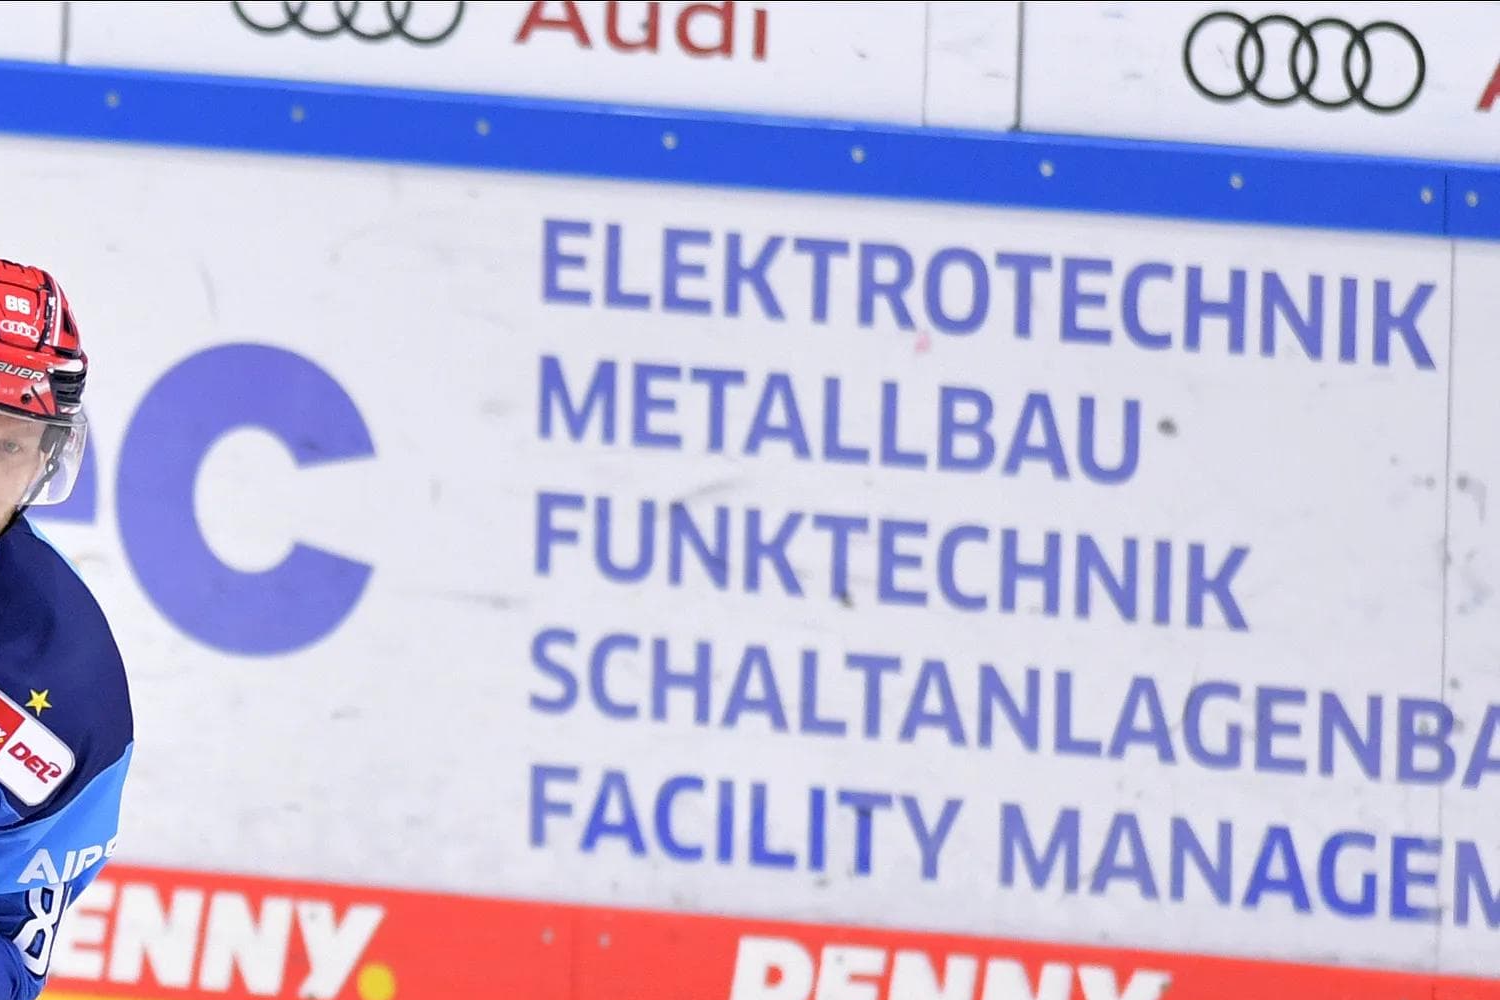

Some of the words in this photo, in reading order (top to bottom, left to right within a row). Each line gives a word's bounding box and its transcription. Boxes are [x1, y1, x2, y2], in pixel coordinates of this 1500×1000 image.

[540, 217, 1437, 371] ELEKTROTECHNIK
[536, 353, 1143, 485] METALLBAU
[533, 489, 1252, 634] FUNKTECHNIK
[527, 764, 964, 880] FACILITY
